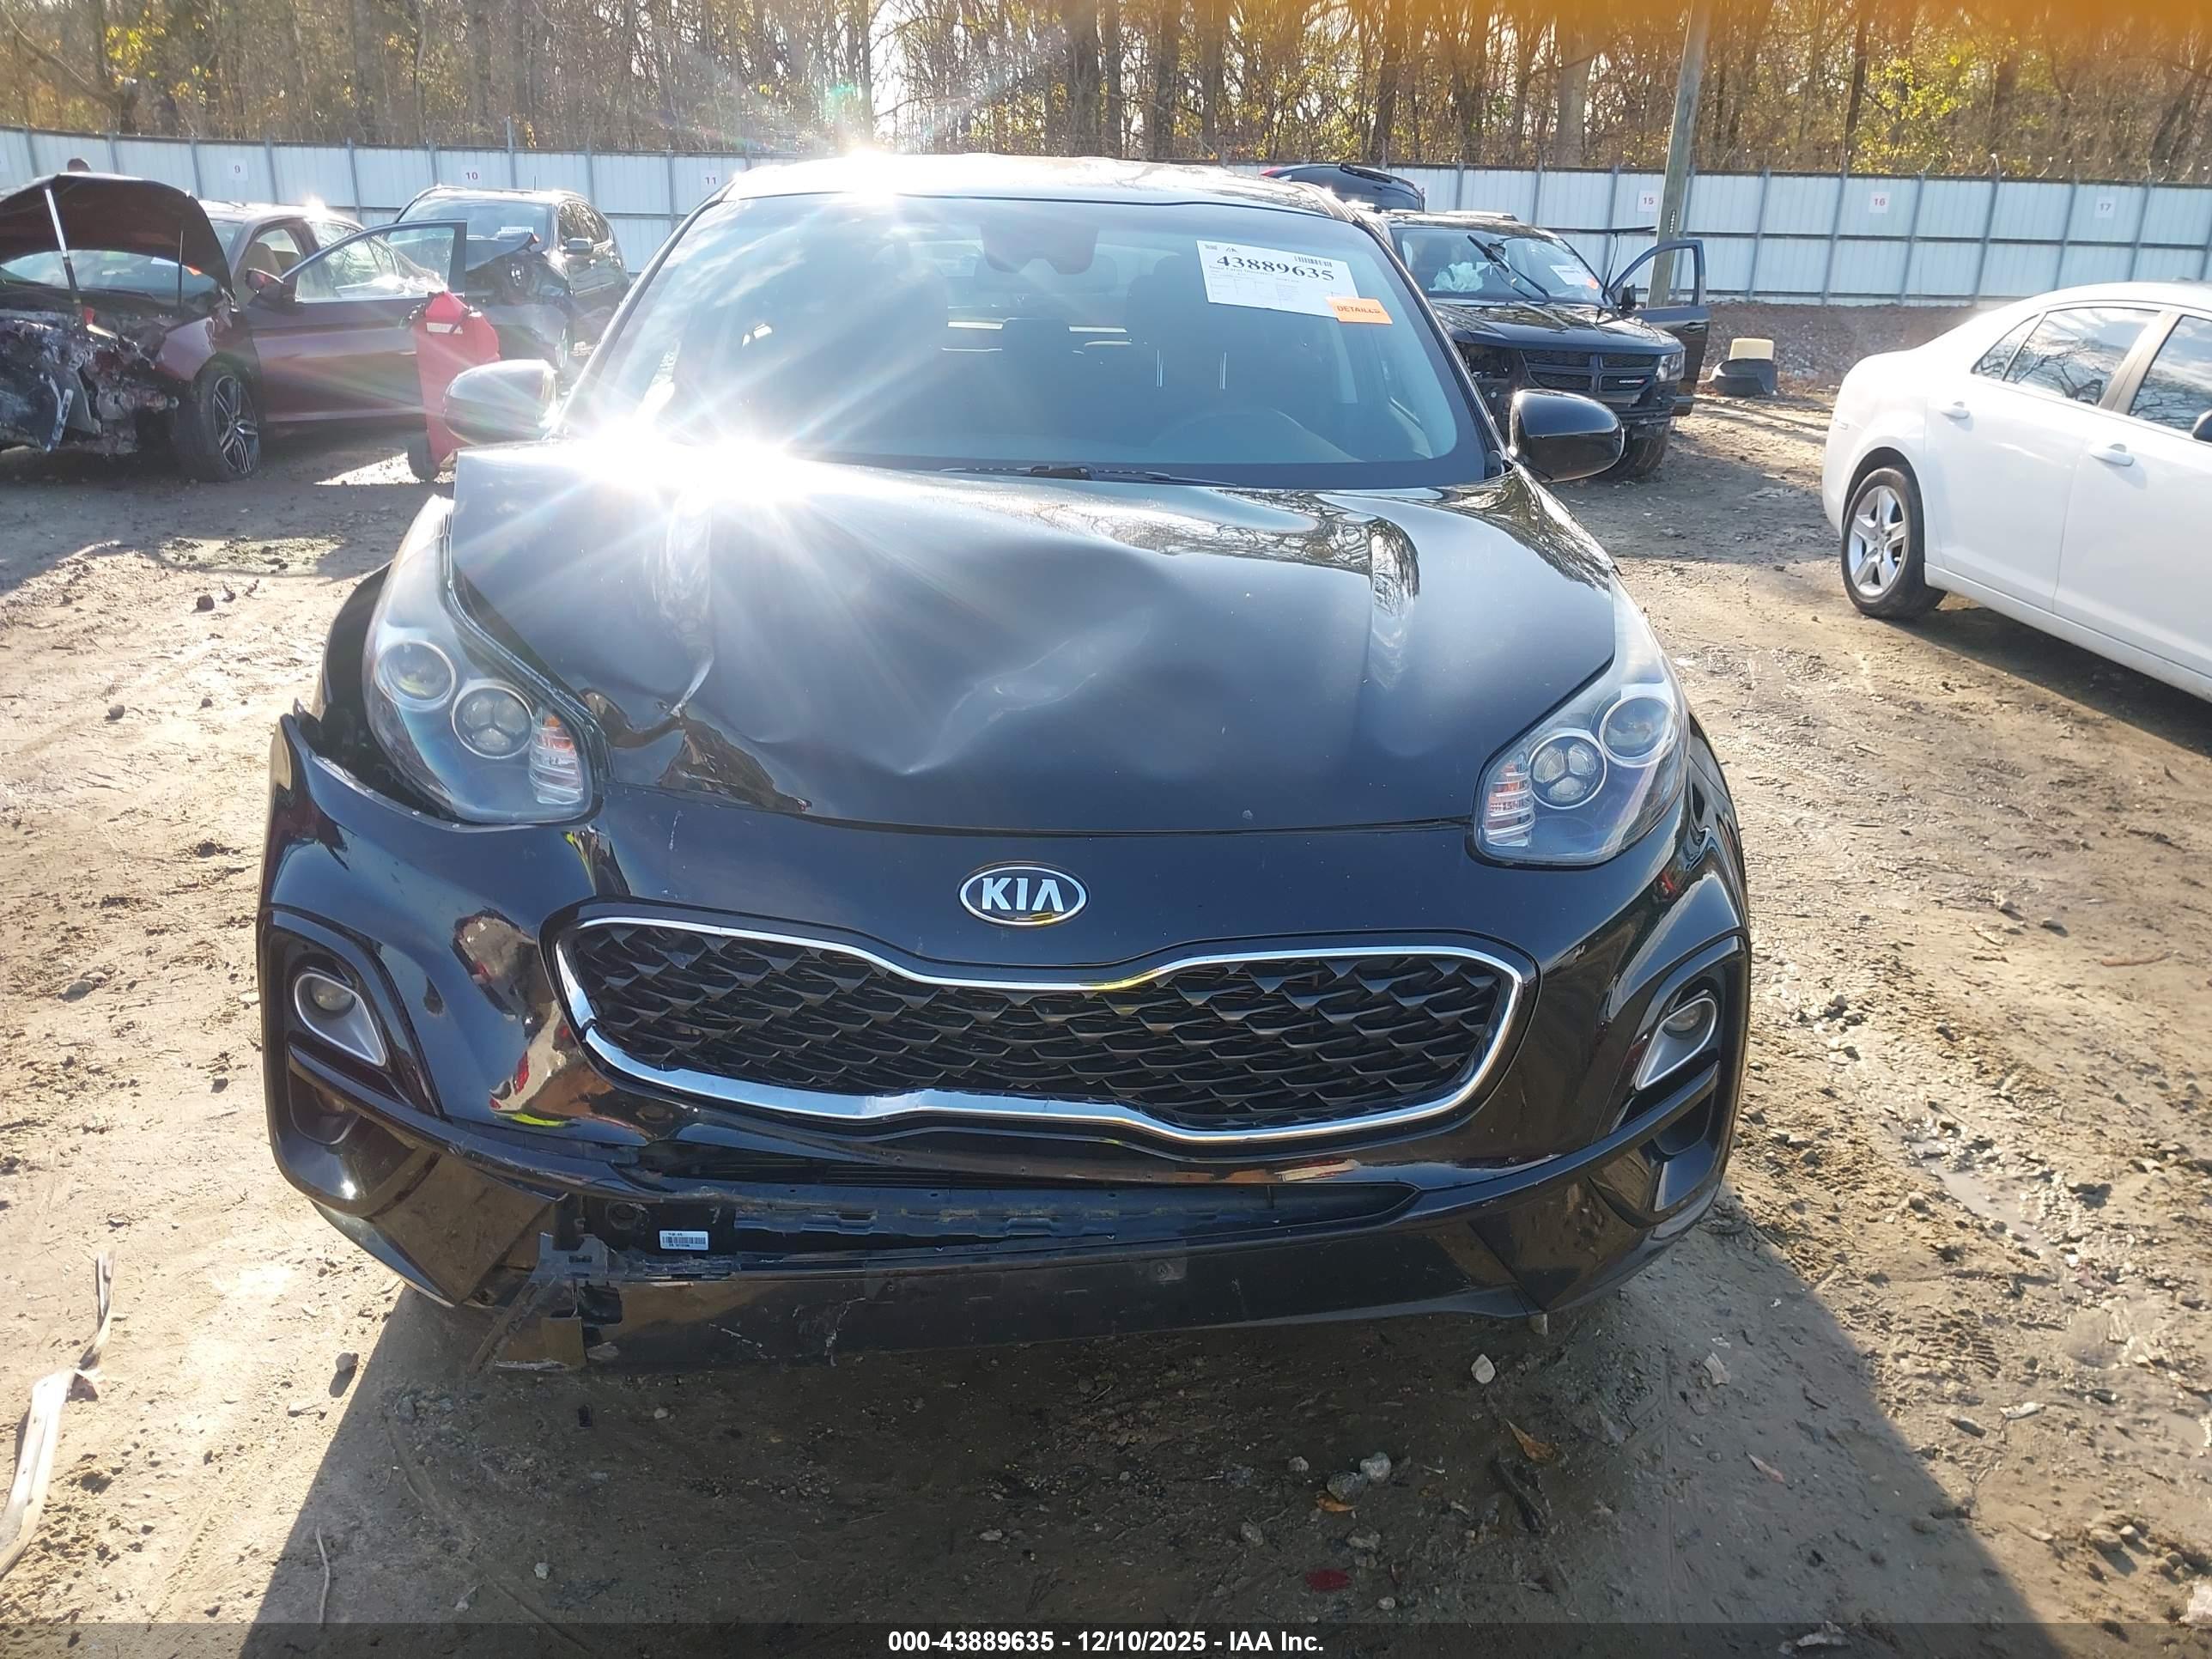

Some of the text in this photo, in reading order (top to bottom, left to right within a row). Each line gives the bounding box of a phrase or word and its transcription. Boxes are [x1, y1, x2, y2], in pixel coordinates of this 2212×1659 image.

[234, 165, 240, 173] 9
[2100, 203, 2112, 211] 17
[1216, 256, 1334, 282] 43889635
[981, 878, 1065, 912] KIA
